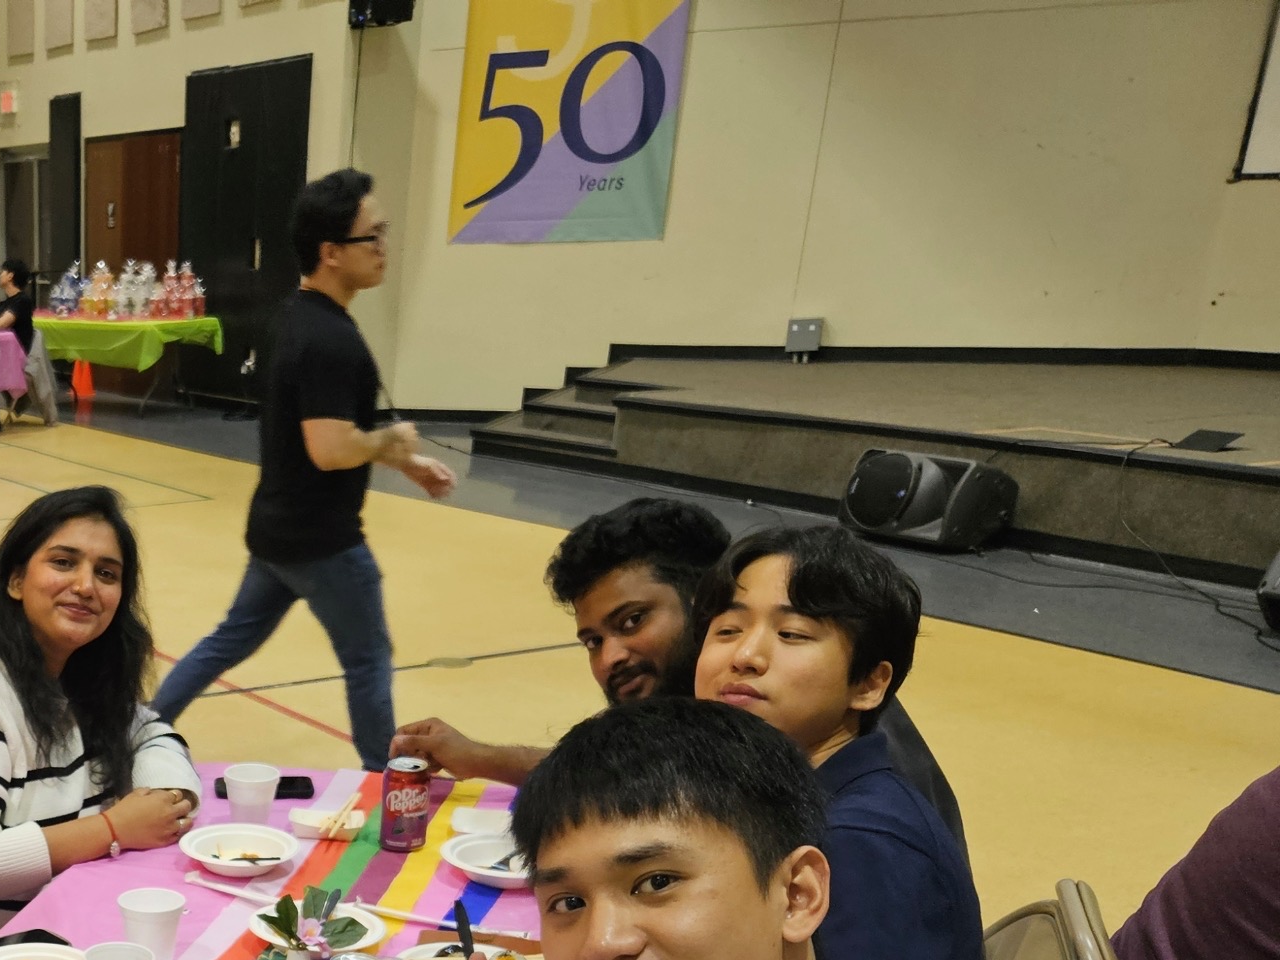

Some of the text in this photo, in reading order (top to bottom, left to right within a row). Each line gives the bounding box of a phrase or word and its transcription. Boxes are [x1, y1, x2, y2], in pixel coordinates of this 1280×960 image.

[463, 41, 666, 209] 50
[578, 174, 624, 192] Years
[387, 789, 428, 812] Pepper
